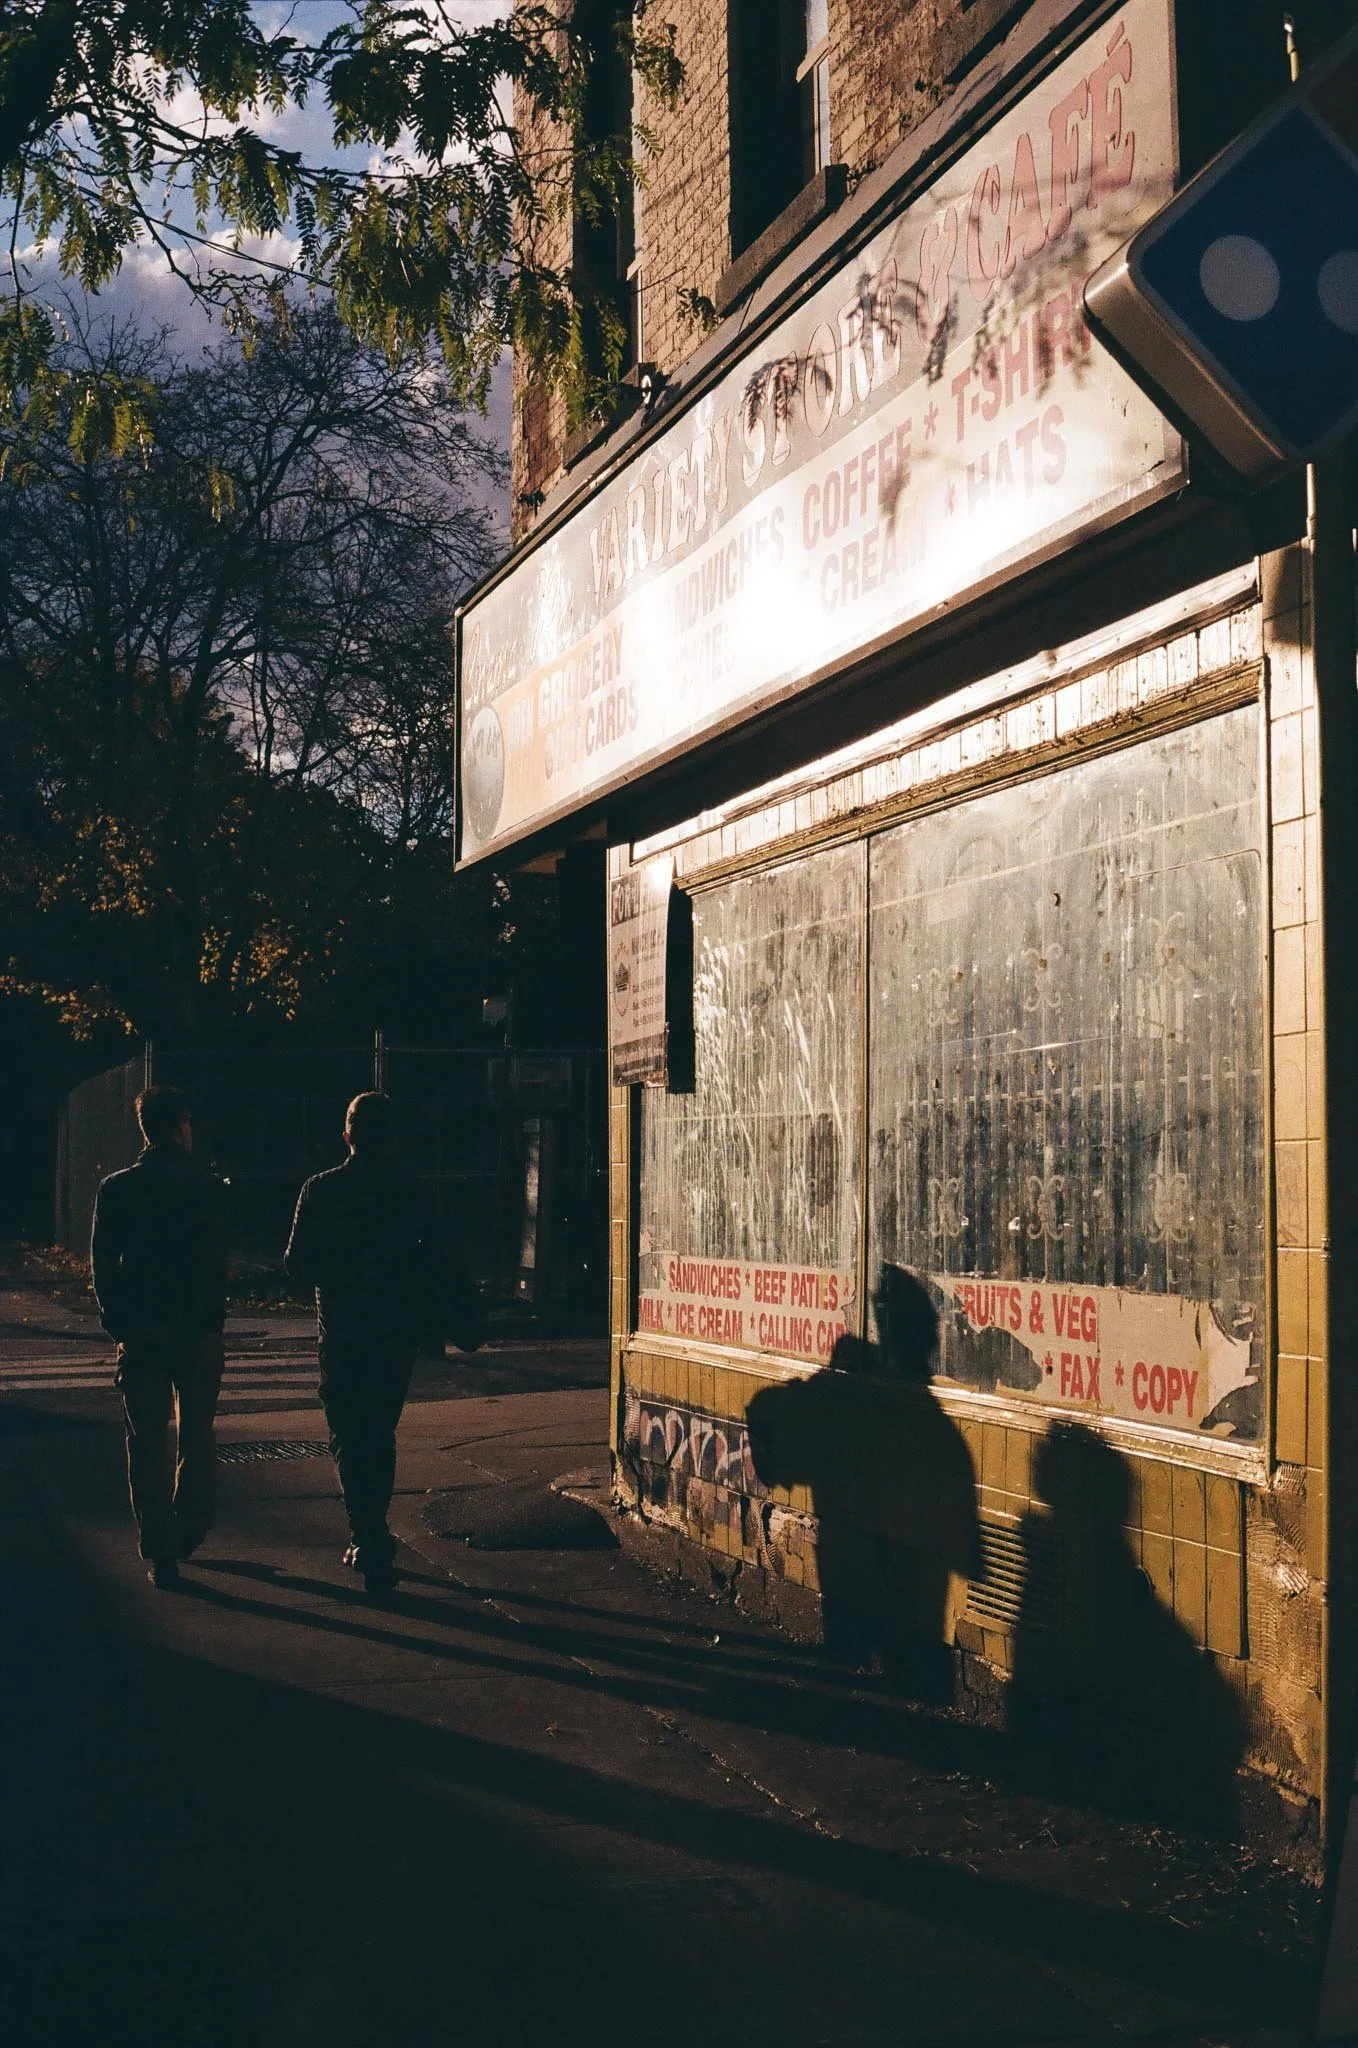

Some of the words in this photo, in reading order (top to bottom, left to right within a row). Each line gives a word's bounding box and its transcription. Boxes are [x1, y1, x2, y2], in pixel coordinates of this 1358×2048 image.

[590, 408, 731, 607] VARIETY
[742, 257, 900, 487] STORE
[966, 20, 1135, 299] CAFÉ
[802, 417, 912, 550] COFFEE
[585, 677, 639, 757] CARDS
[966, 403, 1067, 517] HATS
[669, 1261, 741, 1300] SANDWICHES
[754, 1269, 787, 1305] BEEF
[1029, 1290, 1044, 1334] &
[1052, 1293, 1097, 1342] VEG
[638, 1297, 664, 1330] MILK
[675, 1302, 694, 1335] ICE
[698, 1306, 743, 1344] CREAM
[759, 1312, 812, 1353] CALLING
[1060, 1352, 1100, 1401] FAX
[1132, 1361, 1199, 1418] COPY
